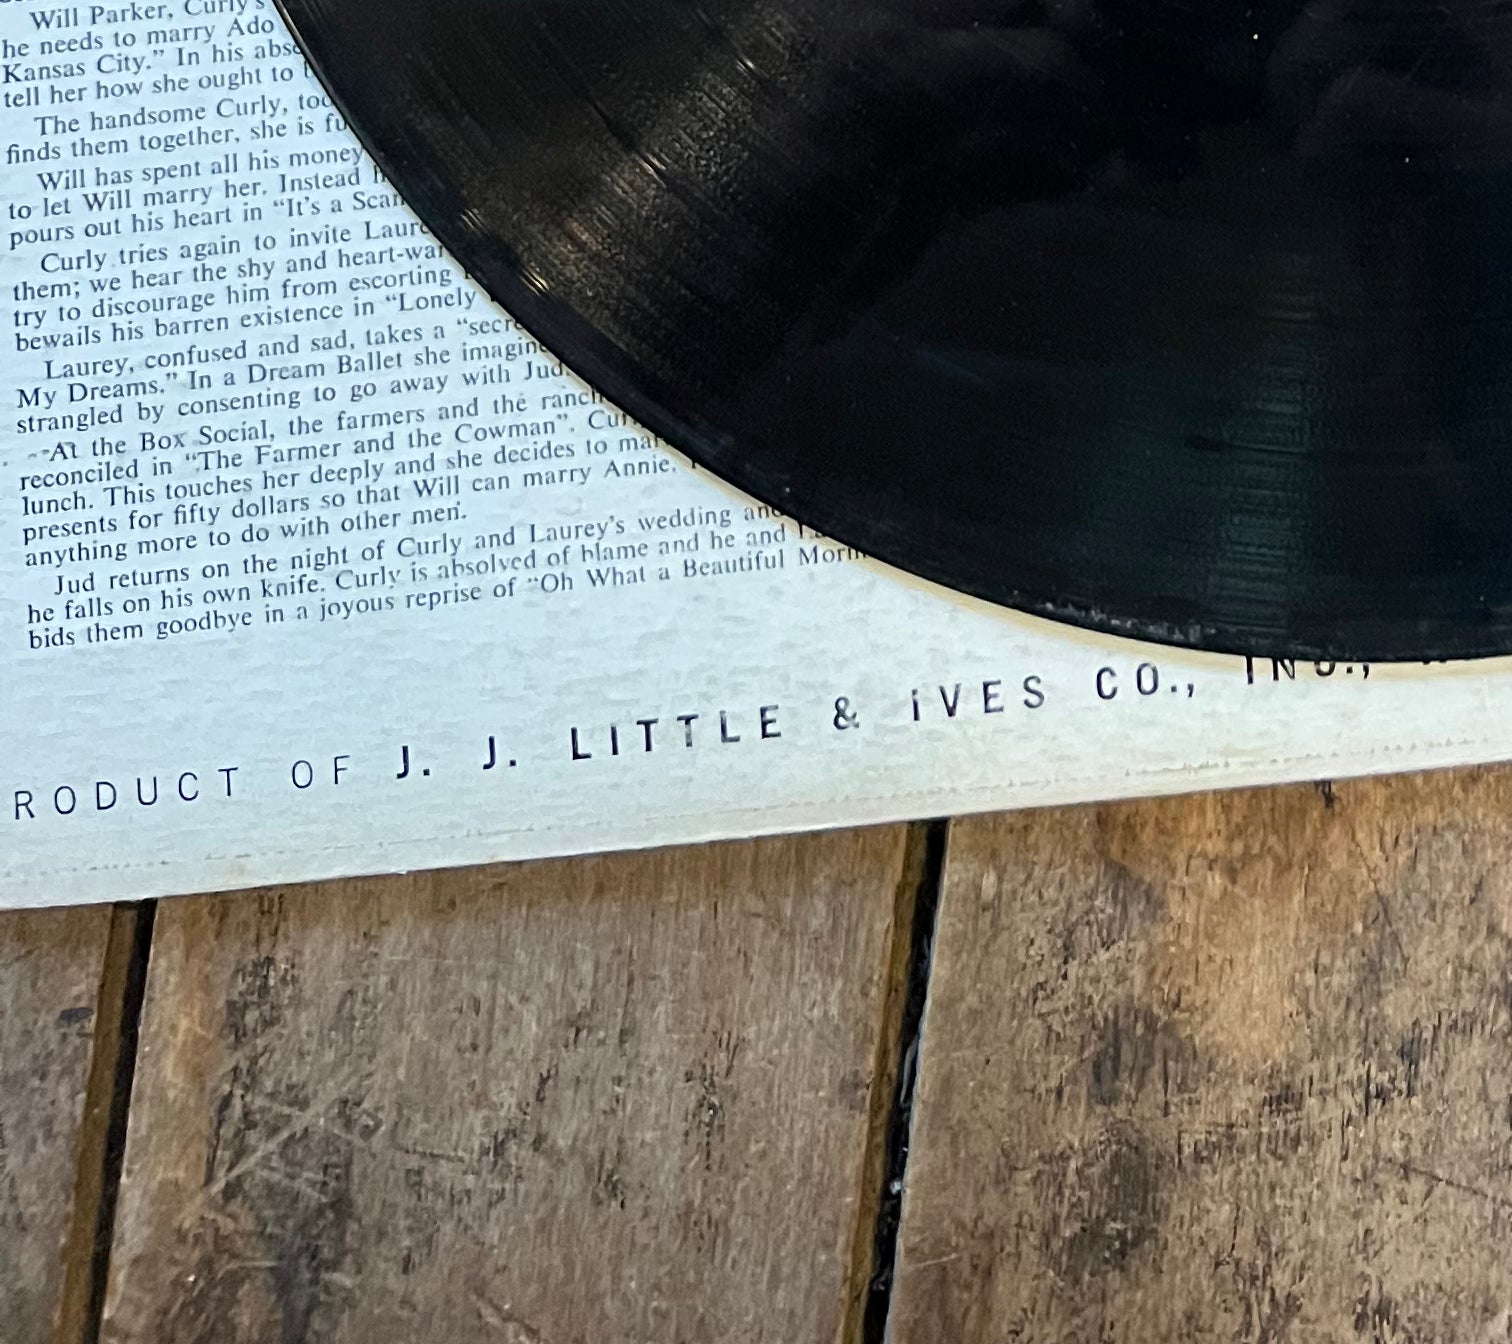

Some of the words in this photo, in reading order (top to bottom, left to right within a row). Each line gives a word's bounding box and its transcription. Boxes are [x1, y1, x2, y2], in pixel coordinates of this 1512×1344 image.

[29, 7, 78, 30] Will
[89, 2, 174, 26] Parker,
[54, 572, 95, 595] Jud
[109, 567, 189, 589] returns
[202, 563, 229, 579] on
[243, 554, 278, 574] the
[291, 546, 349, 571] night
[361, 539, 385, 561] of
[397, 533, 461, 558] Curly
[475, 526, 515, 549] and
[529, 515, 625, 543] Laurey's
[638, 506, 731, 531] wedding
[29, 627, 76, 650] bids
[87, 623, 144, 643] them
[156, 610, 252, 640] goodbye
[265, 604, 284, 623] in
[297, 605, 308, 620] a
[320, 595, 395, 622] joyous
[406, 583, 482, 611] reprise
[493, 577, 517, 598] of
[586, 566, 646, 588] What
[657, 565, 670, 580] a
[683, 549, 784, 578] Beautiful
[291, 755, 350, 789] OF
[395, 744, 431, 780] J.
[483, 735, 517, 770] J.
[570, 704, 782, 761] LITTLE
[832, 696, 860, 730] &
[1095, 662, 1195, 701] CO.,
